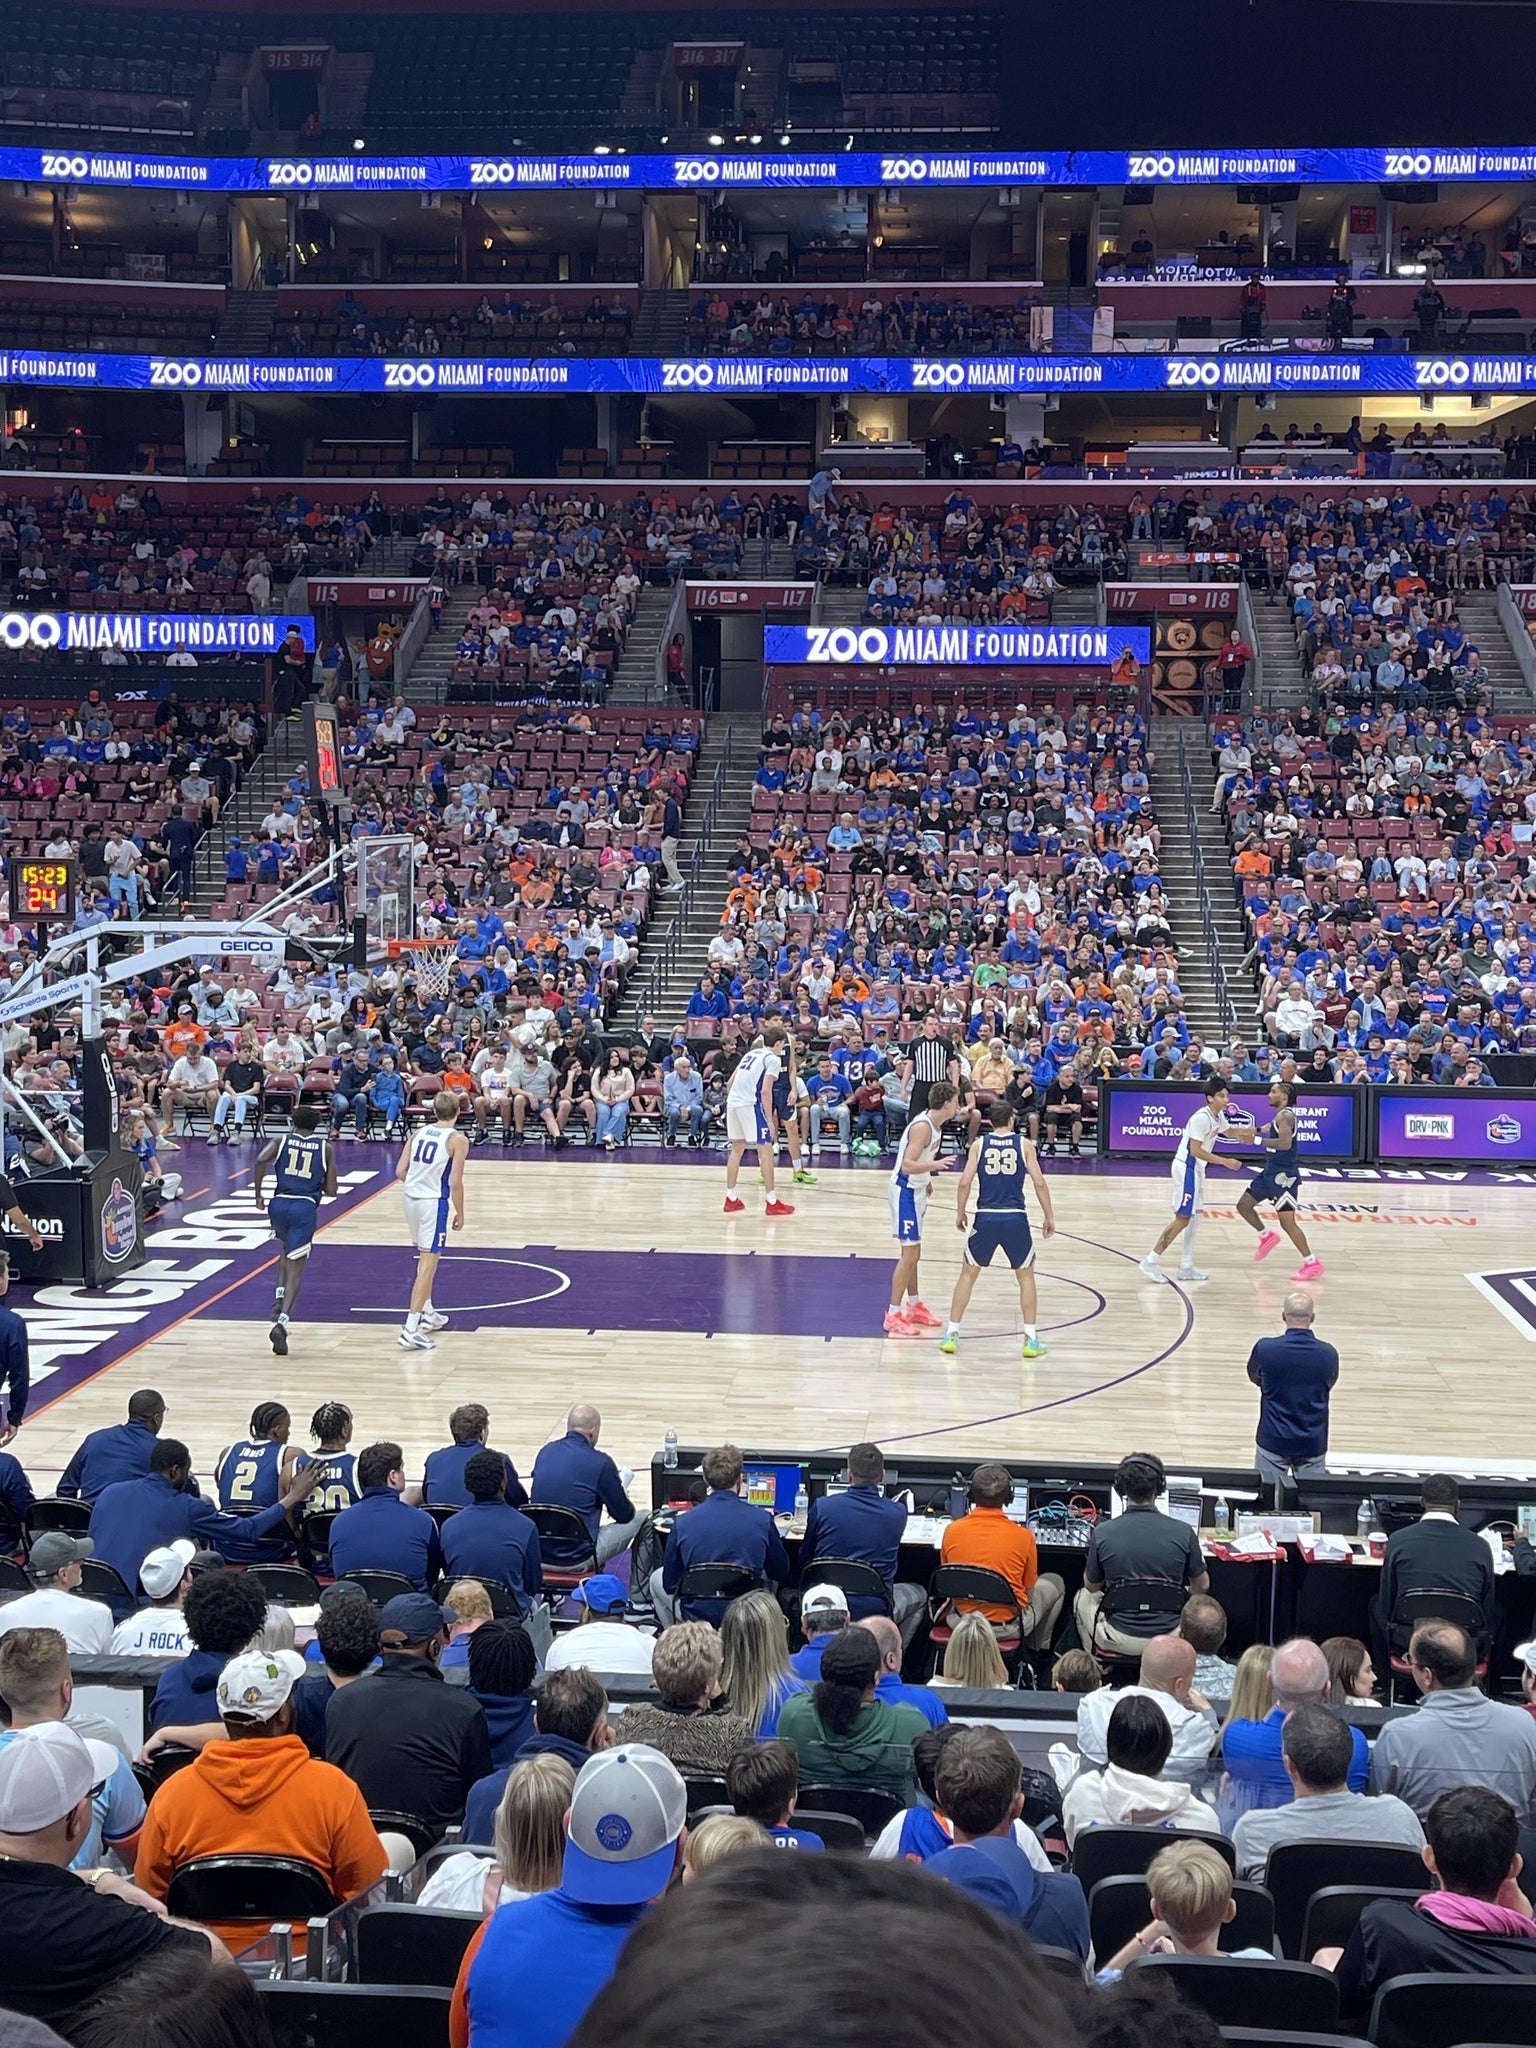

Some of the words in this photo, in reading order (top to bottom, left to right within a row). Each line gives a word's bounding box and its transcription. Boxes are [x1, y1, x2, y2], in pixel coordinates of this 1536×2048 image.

[267, 53, 291, 68] 315
[300, 53, 323, 67] 316
[681, 49, 705, 64] 316
[714, 48, 739, 64] 317
[42, 156, 88, 177] ZOO
[90, 159, 132, 179] MIAMI
[135, 164, 207, 180] FOUNDATION
[269, 164, 312, 183] ZOO
[315, 164, 354, 182] MIAMI
[357, 166, 426, 180] FOUNDATION
[470, 163, 514, 182] ZOO
[517, 163, 557, 181] MIAMI
[559, 165, 630, 179] FOUNDATION
[675, 161, 719, 181] ZOO
[722, 161, 762, 180] MIAMI
[765, 163, 837, 177] FOUNDATION
[881, 159, 927, 179] ZOO
[929, 160, 970, 178] MIAMI
[973, 161, 1045, 176] FOUNDATION
[1129, 157, 1175, 177] ZOO
[1178, 157, 1219, 176] MIAMI
[1222, 159, 1296, 173] FOUNDATION
[1385, 155, 1431, 175] ZOO
[1434, 155, 1477, 174] MIAMI
[12, 359, 96, 377] FOUNDATION
[150, 362, 201, 384] ZOO
[204, 363, 249, 384] MIAMI
[253, 366, 333, 382] FOUNDATION
[384, 363, 435, 386] ZOO
[438, 364, 483, 385] MIAMI
[487, 367, 568, 382] FOUNDATION
[662, 363, 713, 386] ZOO
[717, 364, 763, 385] MIAMI
[766, 366, 849, 382] FOUNDATION
[913, 363, 964, 386] ZOO
[968, 364, 1015, 385] MIAMI
[1019, 366, 1102, 382] FOUNDATION
[1167, 362, 1220, 385] ZOO
[1223, 362, 1271, 383] MIAMI
[1275, 364, 1360, 380] FOUNDATION
[1416, 360, 1469, 383] ZOO
[1473, 361, 1522, 383] MIAMI
[315, 586, 339, 601] 115
[694, 589, 718, 607] 116
[782, 590, 807, 607] 117
[1112, 591, 1138, 608] 117
[1204, 592, 1231, 609] 118
[67, 616, 142, 648] MIAMI
[148, 622, 275, 645] FOUNDATION
[806, 627, 889, 661] ZOO
[894, 629, 969, 661] MIAMI
[975, 633, 1108, 657] FOUNDATION
[22, 865, 67, 886] 15:23
[27, 887, 58, 912] 24
[220, 940, 274, 952] GEICO
[48, 982, 80, 999] Sports
[843, 1060, 864, 1081] 13
[1143, 1105, 1167, 1115] ZOO
[1139, 1116, 1173, 1126] MIAMI
[1297, 1119, 1318, 1130] ANK
[1409, 1119, 1428, 1134] DRV
[1431, 1120, 1449, 1134] PNK
[761, 1127, 770, 1140] F
[1297, 1132, 1322, 1142] RENA
[413, 1138, 439, 1164] 10
[284, 1148, 314, 1180] 11
[984, 1148, 1018, 1176] 33
[1181, 1193, 1192, 1207] F
[903, 1220, 915, 1235] F
[437, 1232, 448, 1248] F
[230, 1460, 259, 1501] 2
[133, 1631, 144, 1648] J
[148, 1632, 185, 1651] ROCK
